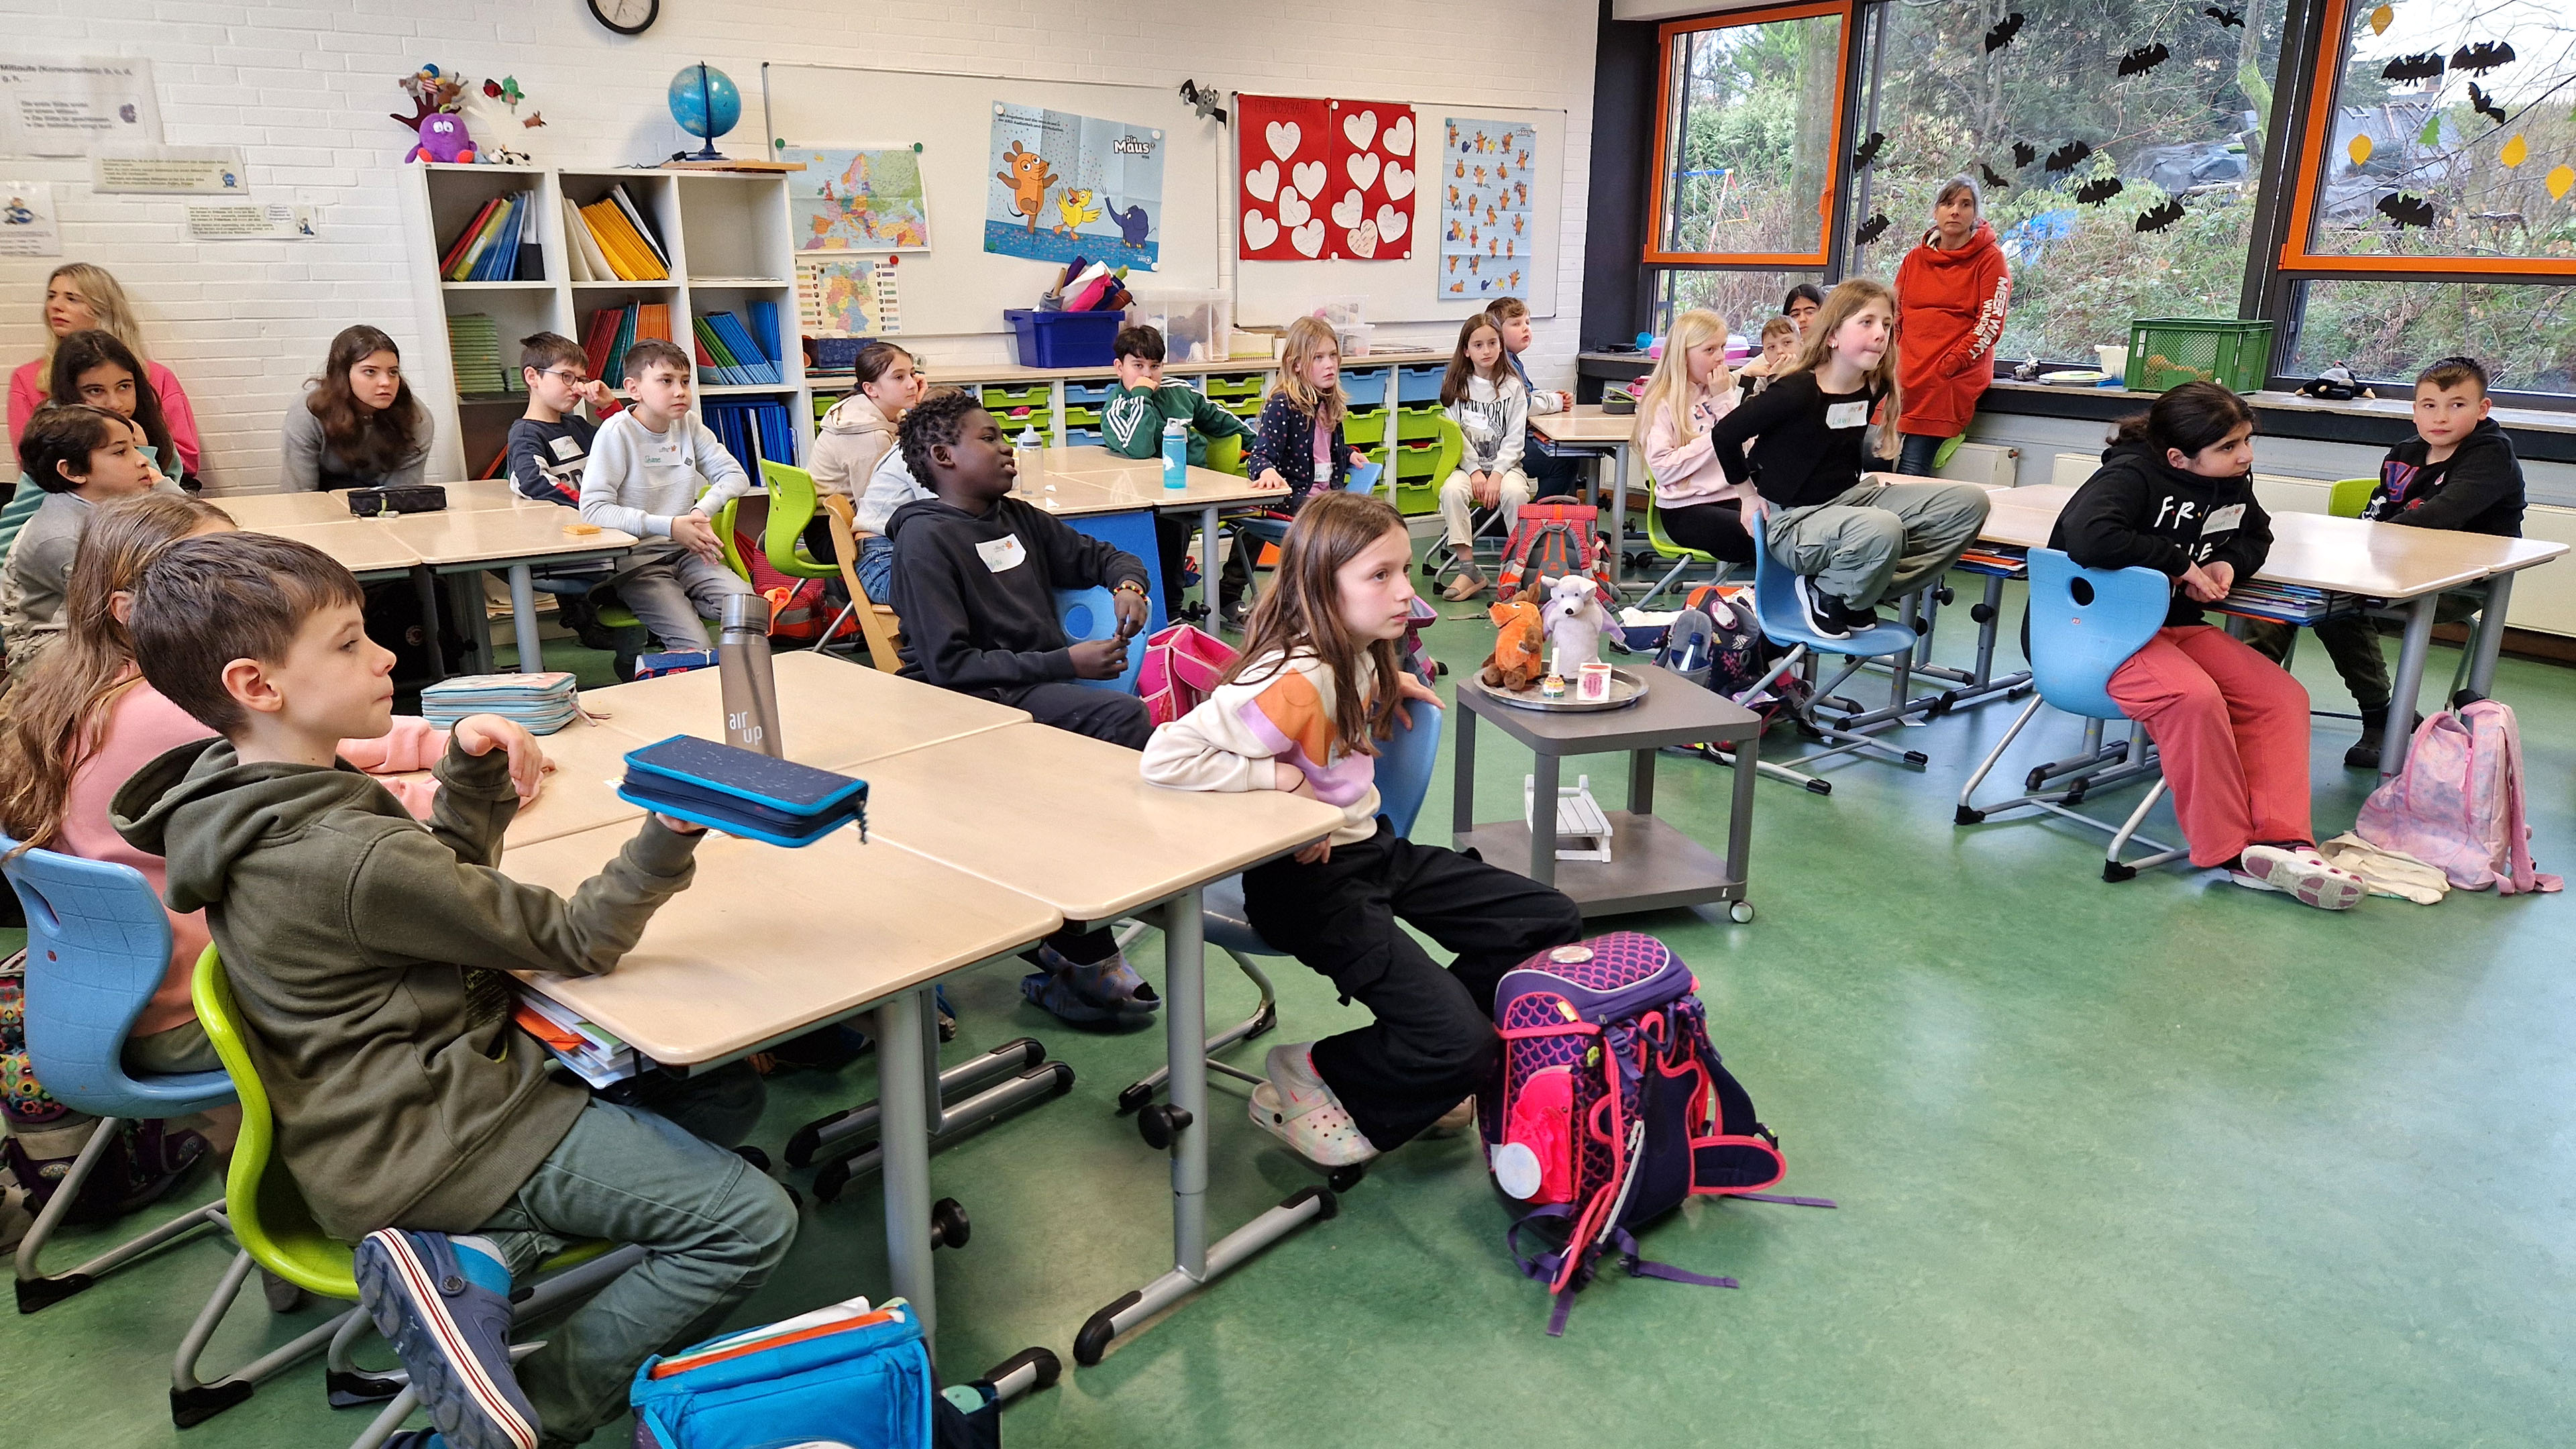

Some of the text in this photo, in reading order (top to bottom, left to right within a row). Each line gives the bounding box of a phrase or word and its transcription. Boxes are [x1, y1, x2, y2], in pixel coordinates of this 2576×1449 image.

[1114, 140, 1150, 154] Maus
[1125, 135, 1138, 144] Die
[1991, 276, 2008, 317] MEER
[1973, 299, 1993, 336] WUNDER
[729, 711, 748, 730] air
[743, 725, 763, 746] up
